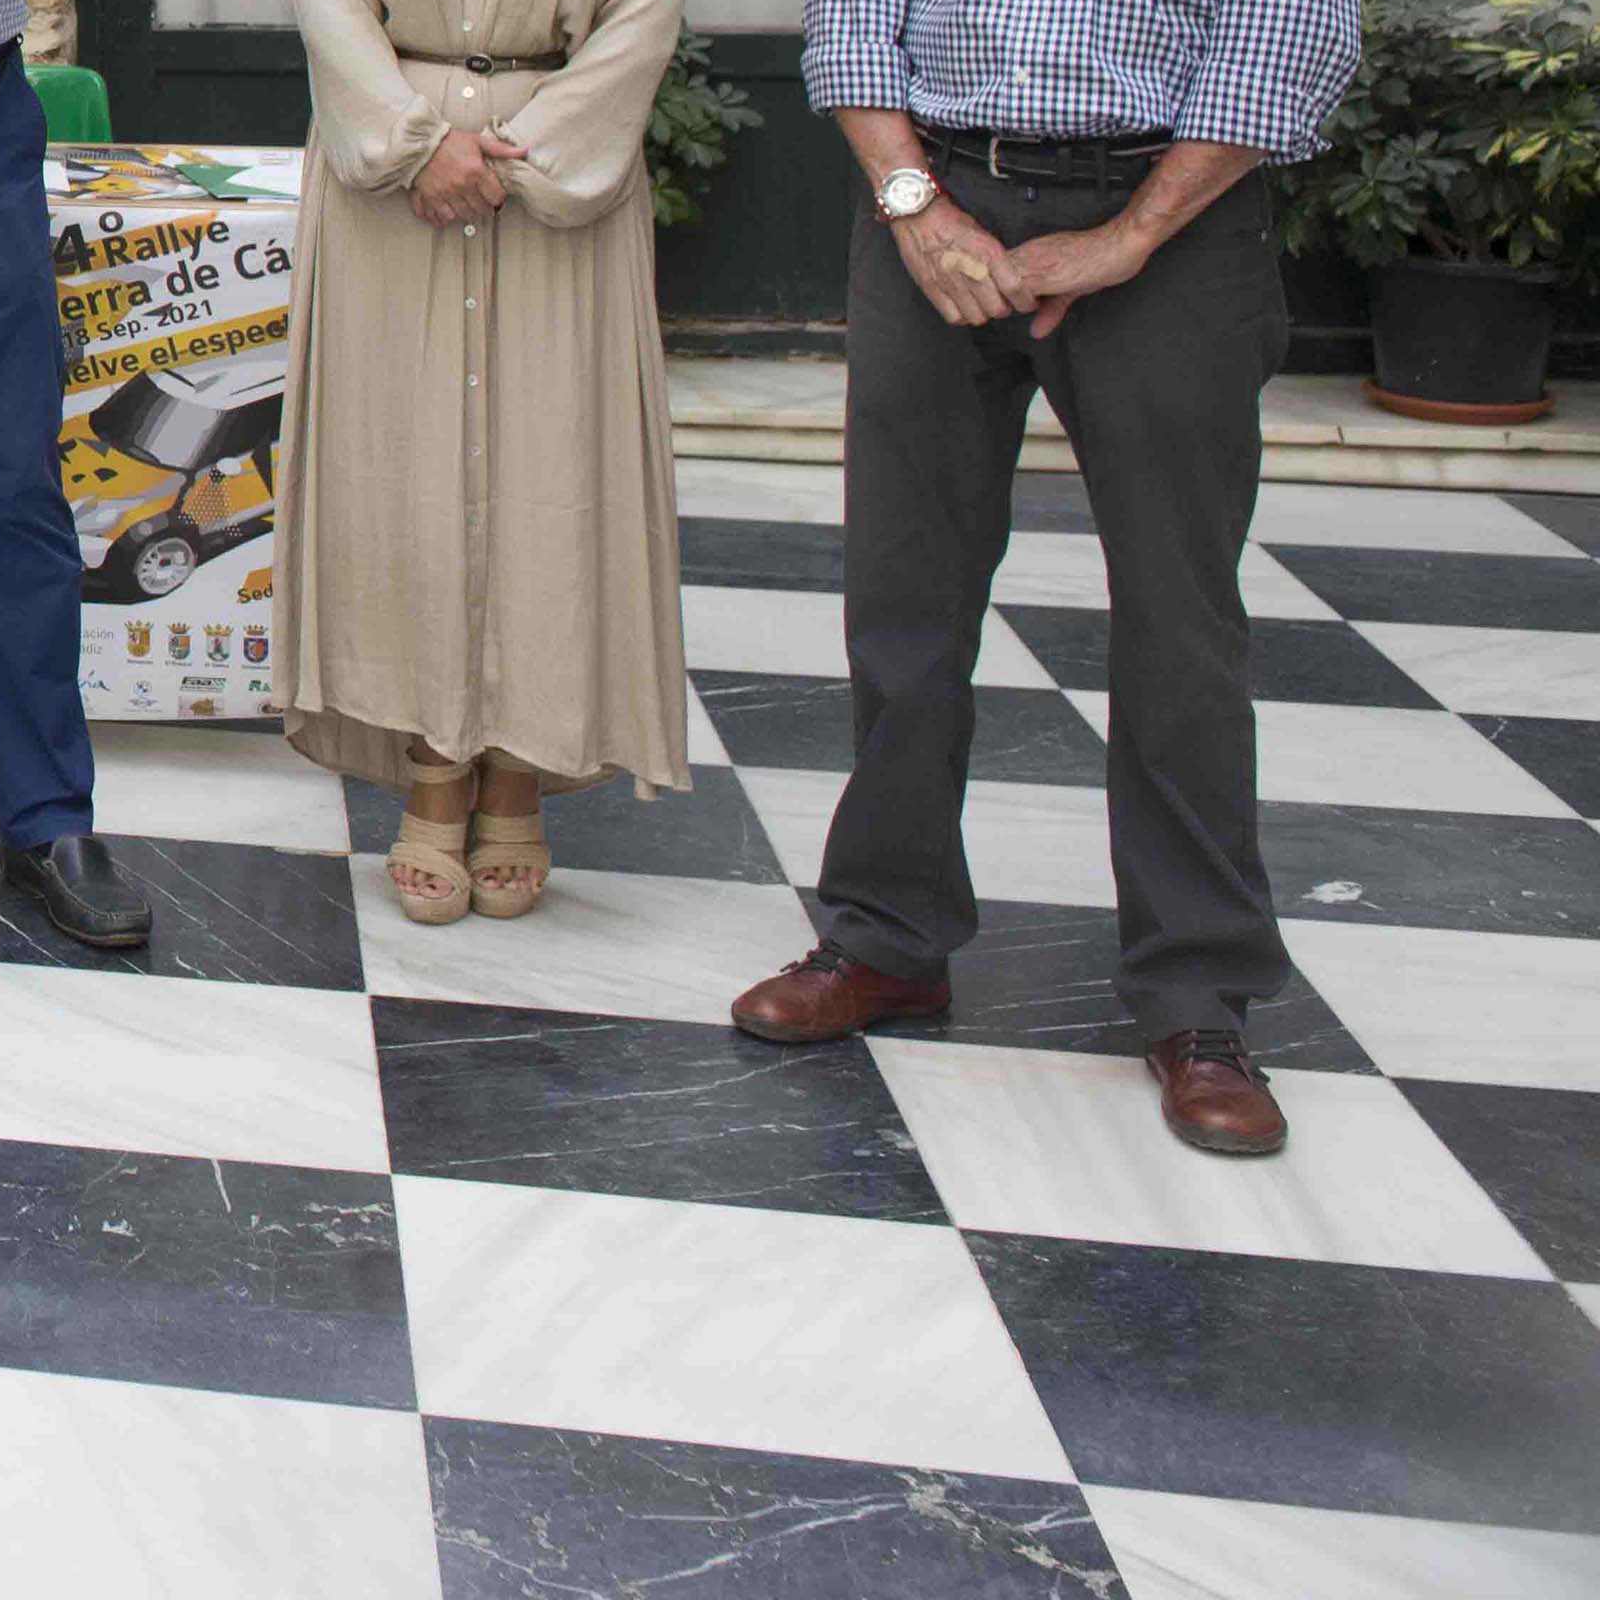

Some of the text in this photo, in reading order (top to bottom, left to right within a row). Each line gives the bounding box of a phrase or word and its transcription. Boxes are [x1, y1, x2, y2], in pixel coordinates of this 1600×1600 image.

[101, 219, 231, 268] Rallye
[166, 259, 221, 297] de
[97, 318, 148, 342] Sep.
[158, 299, 213, 328] 2021
[150, 337, 180, 366] el
